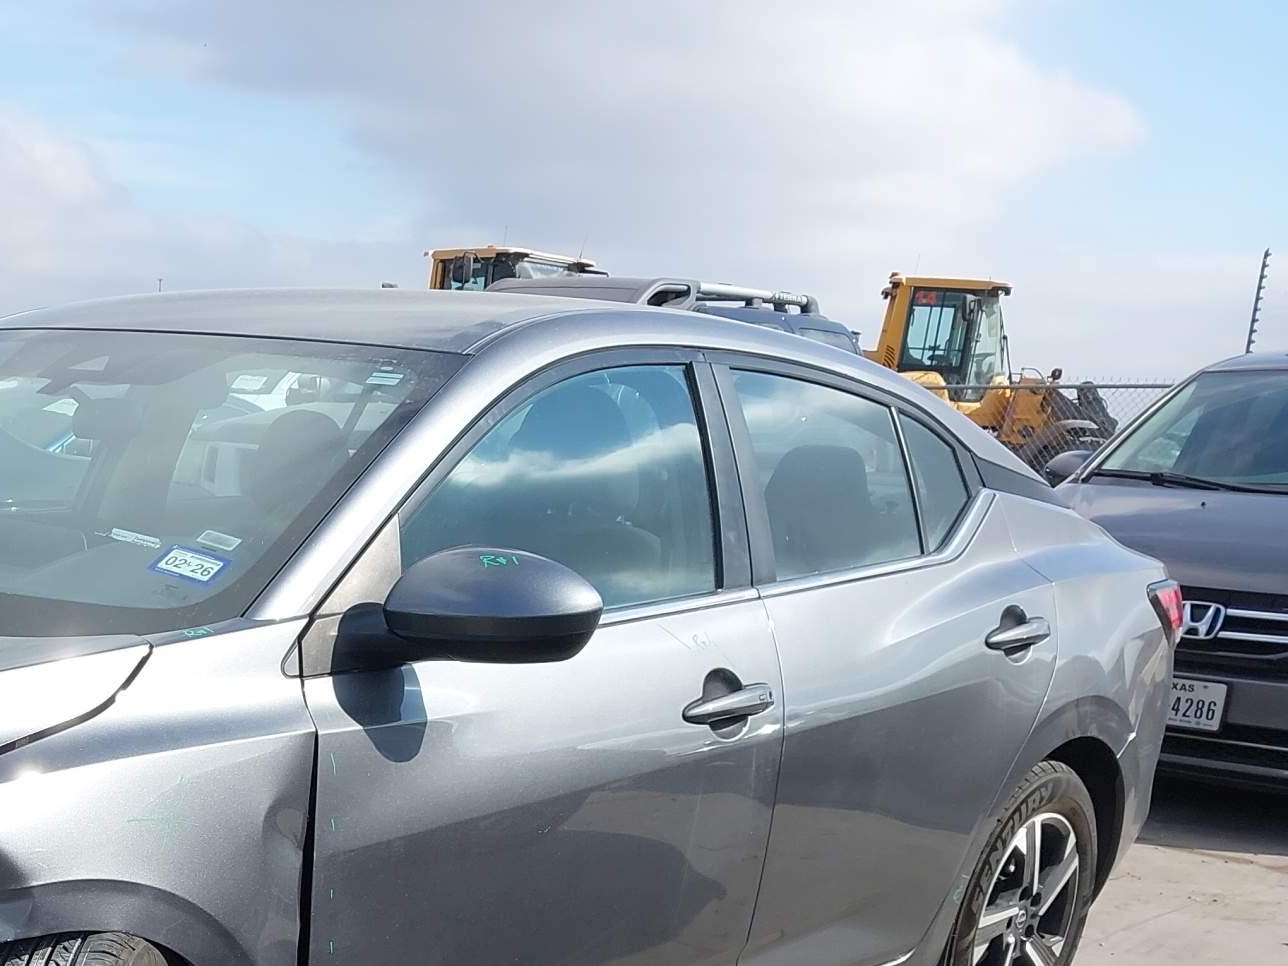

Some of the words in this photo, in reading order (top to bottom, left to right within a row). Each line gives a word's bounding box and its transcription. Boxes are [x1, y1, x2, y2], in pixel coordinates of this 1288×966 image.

[164, 555, 188, 569] 02
[189, 563, 215, 577] 26
[1171, 682, 1195, 693] XAS
[1171, 696, 1218, 721] 4286
